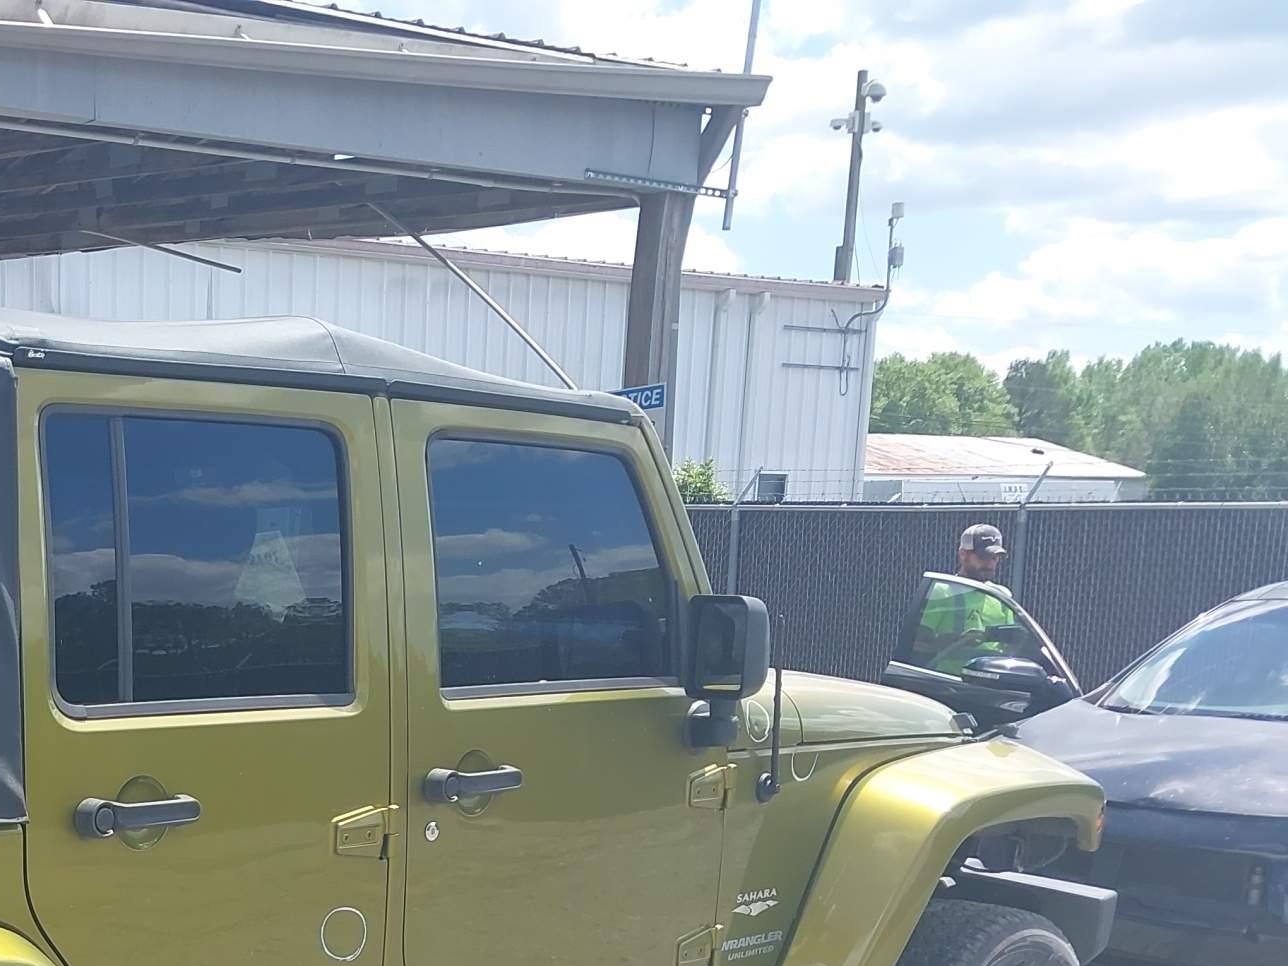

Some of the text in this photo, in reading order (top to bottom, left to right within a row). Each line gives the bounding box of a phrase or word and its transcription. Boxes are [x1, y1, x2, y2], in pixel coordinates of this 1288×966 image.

[622, 388, 662, 407] TICE
[736, 887, 777, 904] SAHARA
[721, 930, 784, 952] WRANGLER
[727, 945, 775, 961] UNLIMITED
